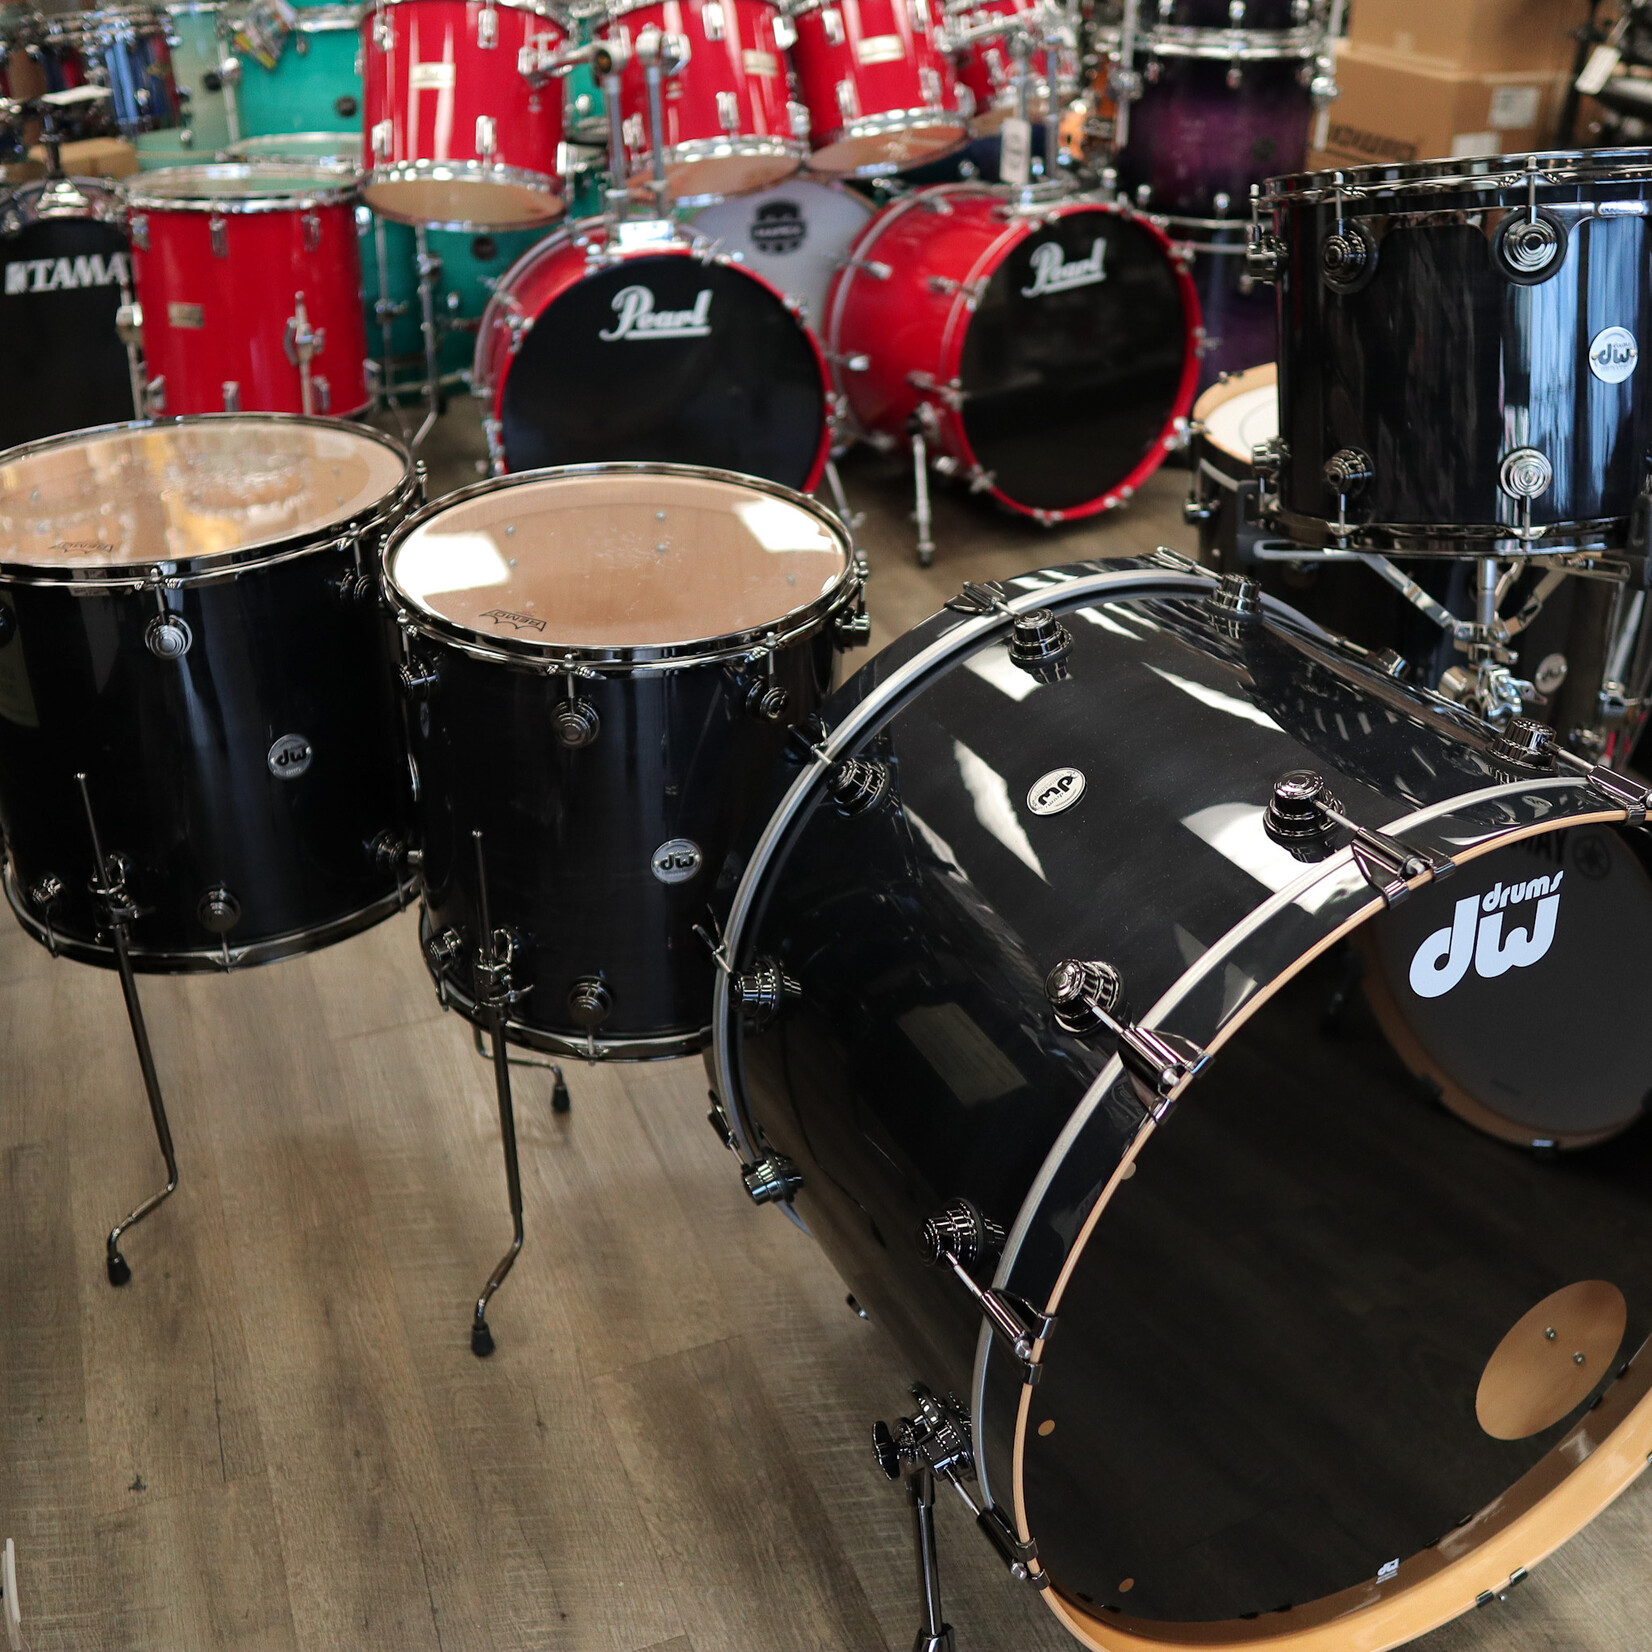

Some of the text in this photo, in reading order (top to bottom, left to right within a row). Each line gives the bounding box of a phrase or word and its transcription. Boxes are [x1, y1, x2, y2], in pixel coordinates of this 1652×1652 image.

[27, 251, 130, 292] TAMA
[1021, 237, 1107, 298] Pearl
[599, 285, 713, 341] Pearl
[1598, 343, 1630, 365] dw
[494, 610, 541, 627] REMO
[275, 749, 307, 766] dw
[1038, 776, 1074, 806] dw
[660, 852, 694, 870] dw
[1482, 870, 1564, 912] drums
[1409, 894, 1560, 998] dw
